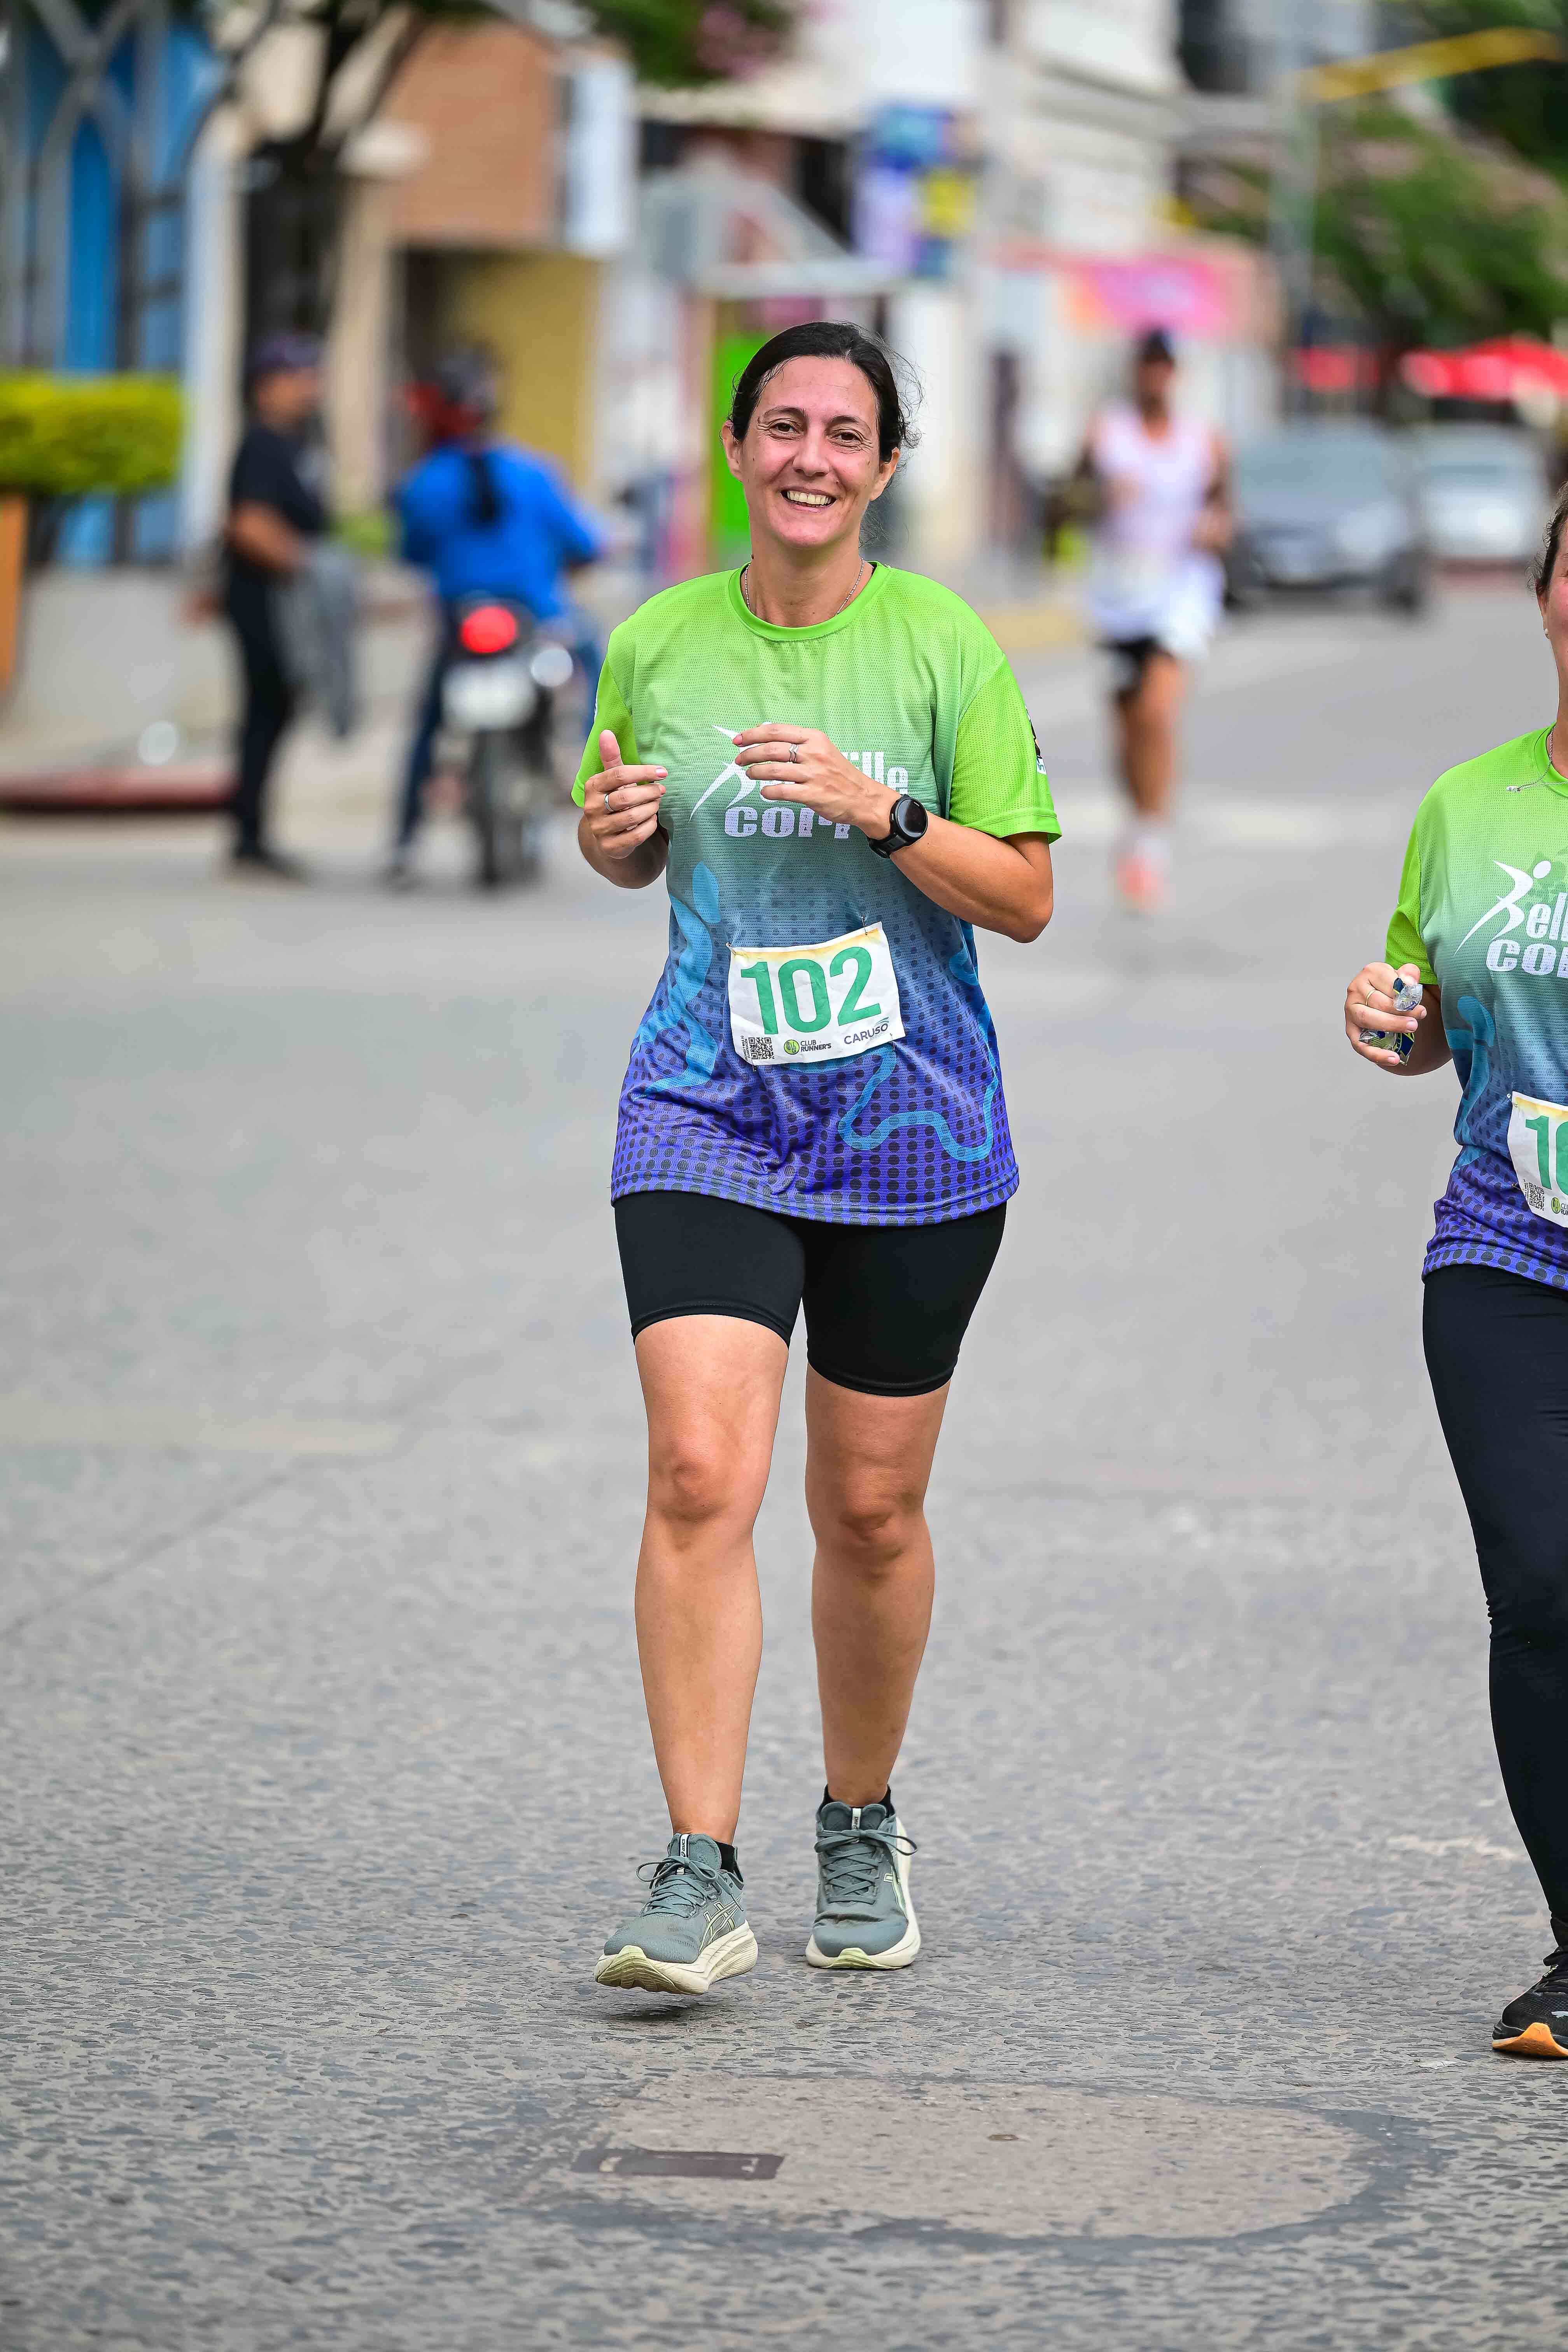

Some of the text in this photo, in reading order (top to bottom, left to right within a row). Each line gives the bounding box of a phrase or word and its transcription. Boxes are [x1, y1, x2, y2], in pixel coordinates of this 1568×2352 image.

[741, 947, 881, 1035] 102
[844, 1023, 888, 1045] CARUSO
[801, 1043, 832, 1052] RUNNER'S
